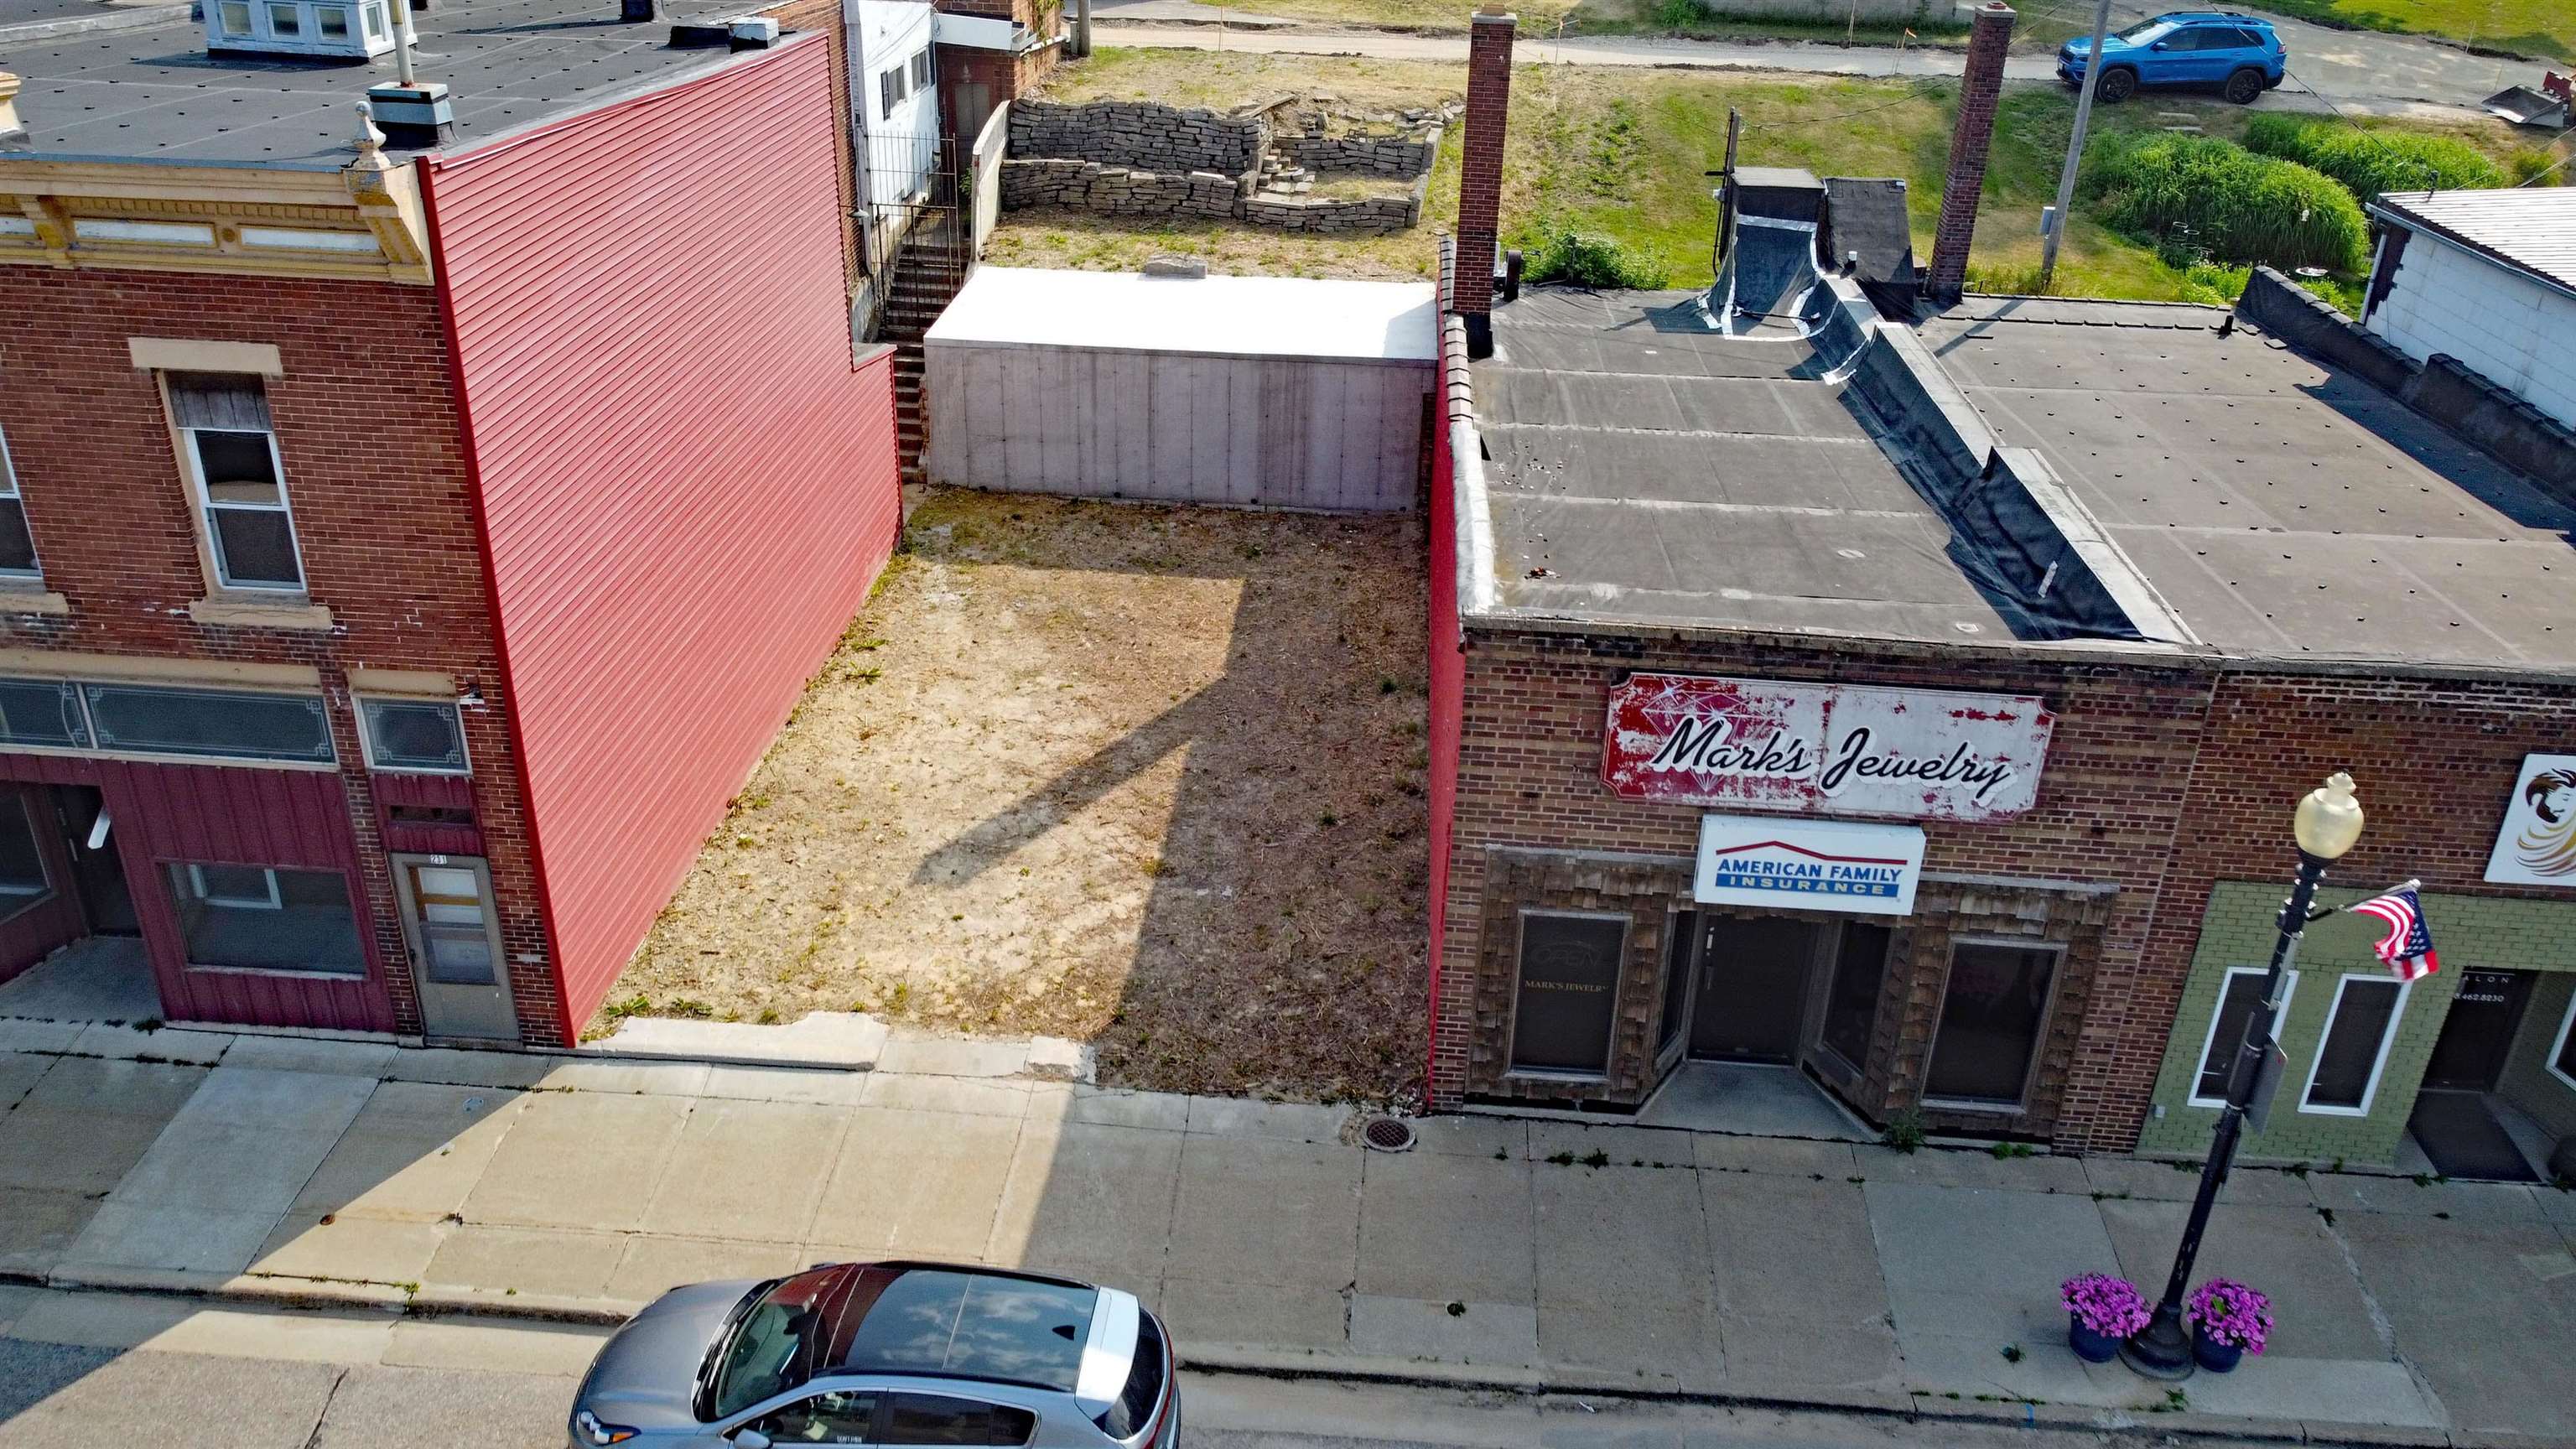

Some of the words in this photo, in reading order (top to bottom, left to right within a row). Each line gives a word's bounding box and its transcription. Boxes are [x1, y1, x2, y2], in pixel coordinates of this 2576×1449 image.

[1652, 716, 1812, 773] Mark's
[1821, 726, 2012, 797] Jewelry
[1717, 859, 1822, 878] AMERICAN
[1830, 865, 1903, 882] FAMILY
[1730, 875, 1886, 895] INSURANCE
[1524, 979, 1564, 990] MARK'S
[1565, 982, 1609, 993] JEWELRY
[2462, 974, 2510, 984] ALON
